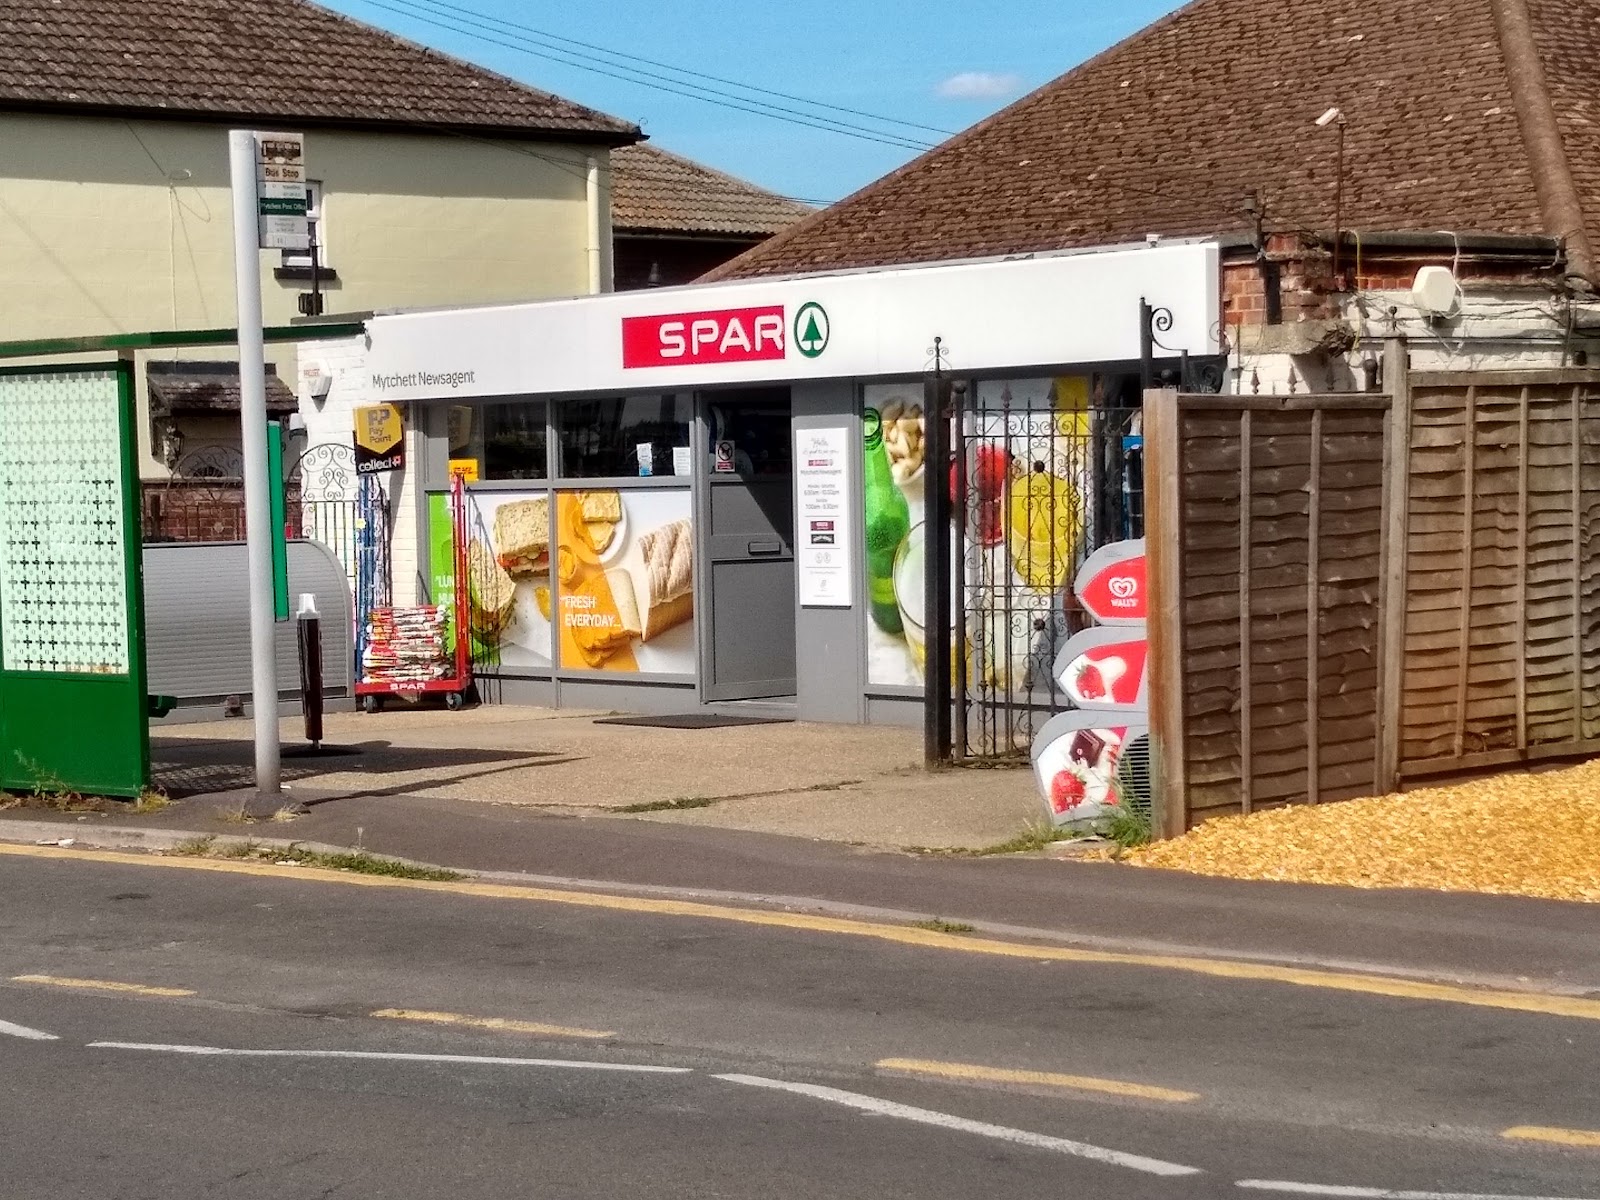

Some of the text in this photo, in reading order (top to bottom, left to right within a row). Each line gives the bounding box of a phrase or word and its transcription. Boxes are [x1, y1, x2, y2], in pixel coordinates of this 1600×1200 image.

[282, 168, 299, 178] Stop
[658, 314, 785, 359] SPAR
[372, 371, 475, 392] Mytchett Newsagent
[369, 435, 392, 443] Point
[389, 682, 426, 691] SPAR
